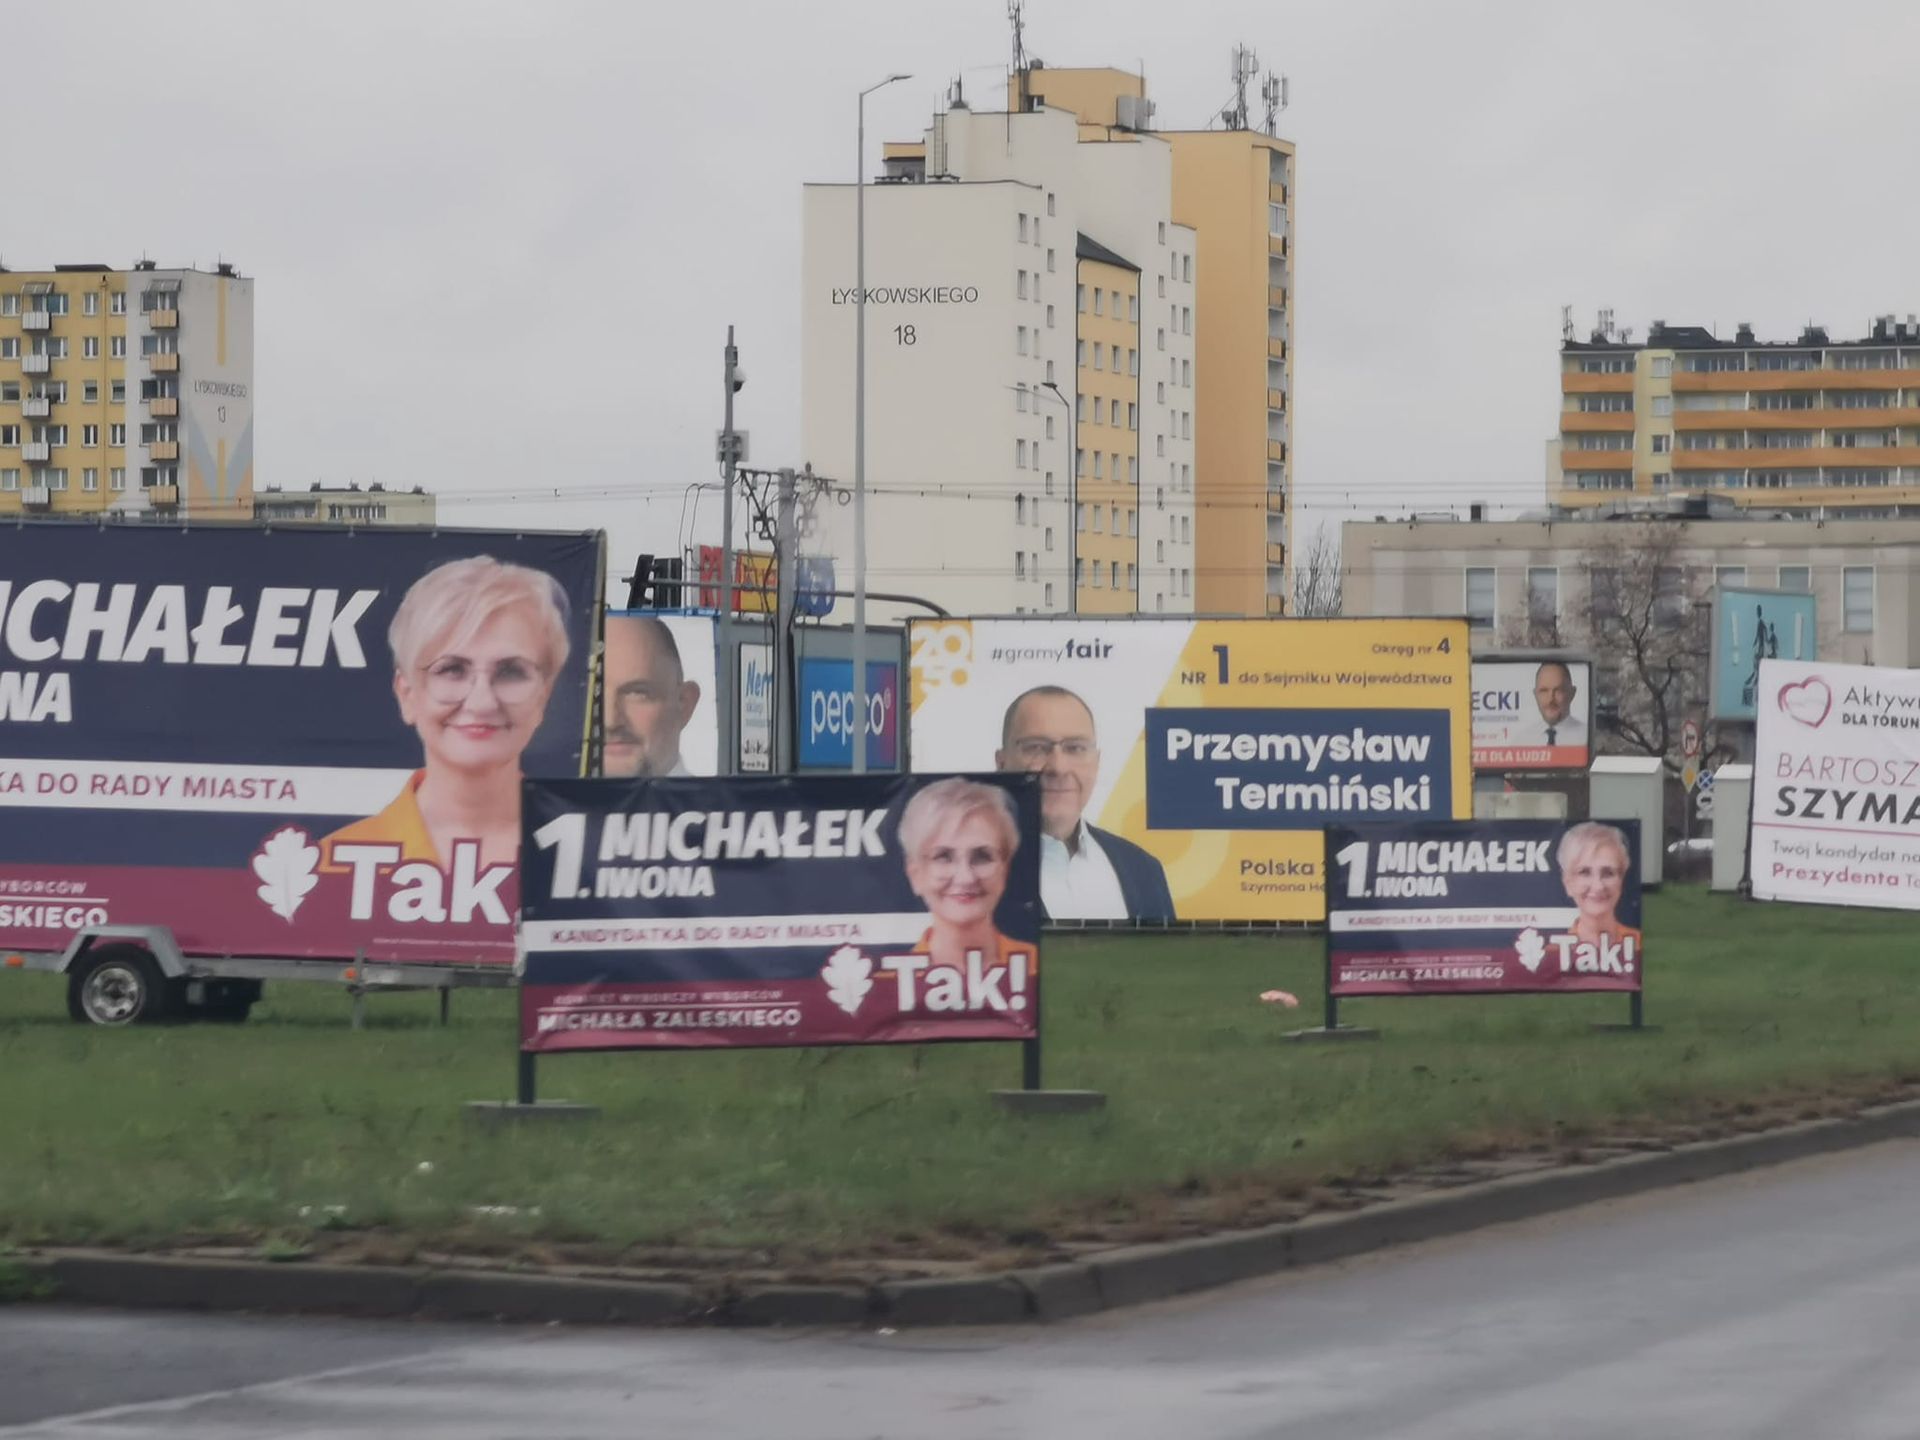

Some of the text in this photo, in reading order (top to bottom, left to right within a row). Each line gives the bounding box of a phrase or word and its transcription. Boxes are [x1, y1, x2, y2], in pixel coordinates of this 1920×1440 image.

[831, 287, 978, 304] ŁYSKOWSKIEGO
[894, 324, 916, 345] 18
[1418, 645, 1432, 655] nr
[1437, 637, 1451, 655] 4
[1181, 671, 1206, 685] NR
[1212, 645, 1229, 685] 1
[1238, 671, 1259, 685] do
[1264, 671, 1331, 689] Sejmiku
[1842, 713, 1868, 726] DLA
[1167, 728, 1430, 771] Przemysław
[1776, 752, 1920, 787] BARTOSZ
[37, 772, 78, 794] DO
[90, 774, 172, 798] RADY
[183, 776, 297, 800] MIASTA
[1216, 775, 1430, 811] Termiński
[598, 808, 889, 861] MICHAŁEK
[1376, 840, 1551, 873] MICHAŁEK
[1816, 842, 1896, 863] kandydat
[1240, 858, 1315, 875] Polska
[1772, 862, 1899, 887] Prezydenta
[595, 866, 715, 898] IWONA
[1375, 876, 1448, 897] IWONA
[552, 923, 862, 944] KANDYDATKA DO RADY MIASTA
[1550, 932, 1634, 973] Tak!
[881, 950, 1026, 1012] Tak!
[537, 1009, 801, 1032] MICHAŁA ZALESKIEGO
